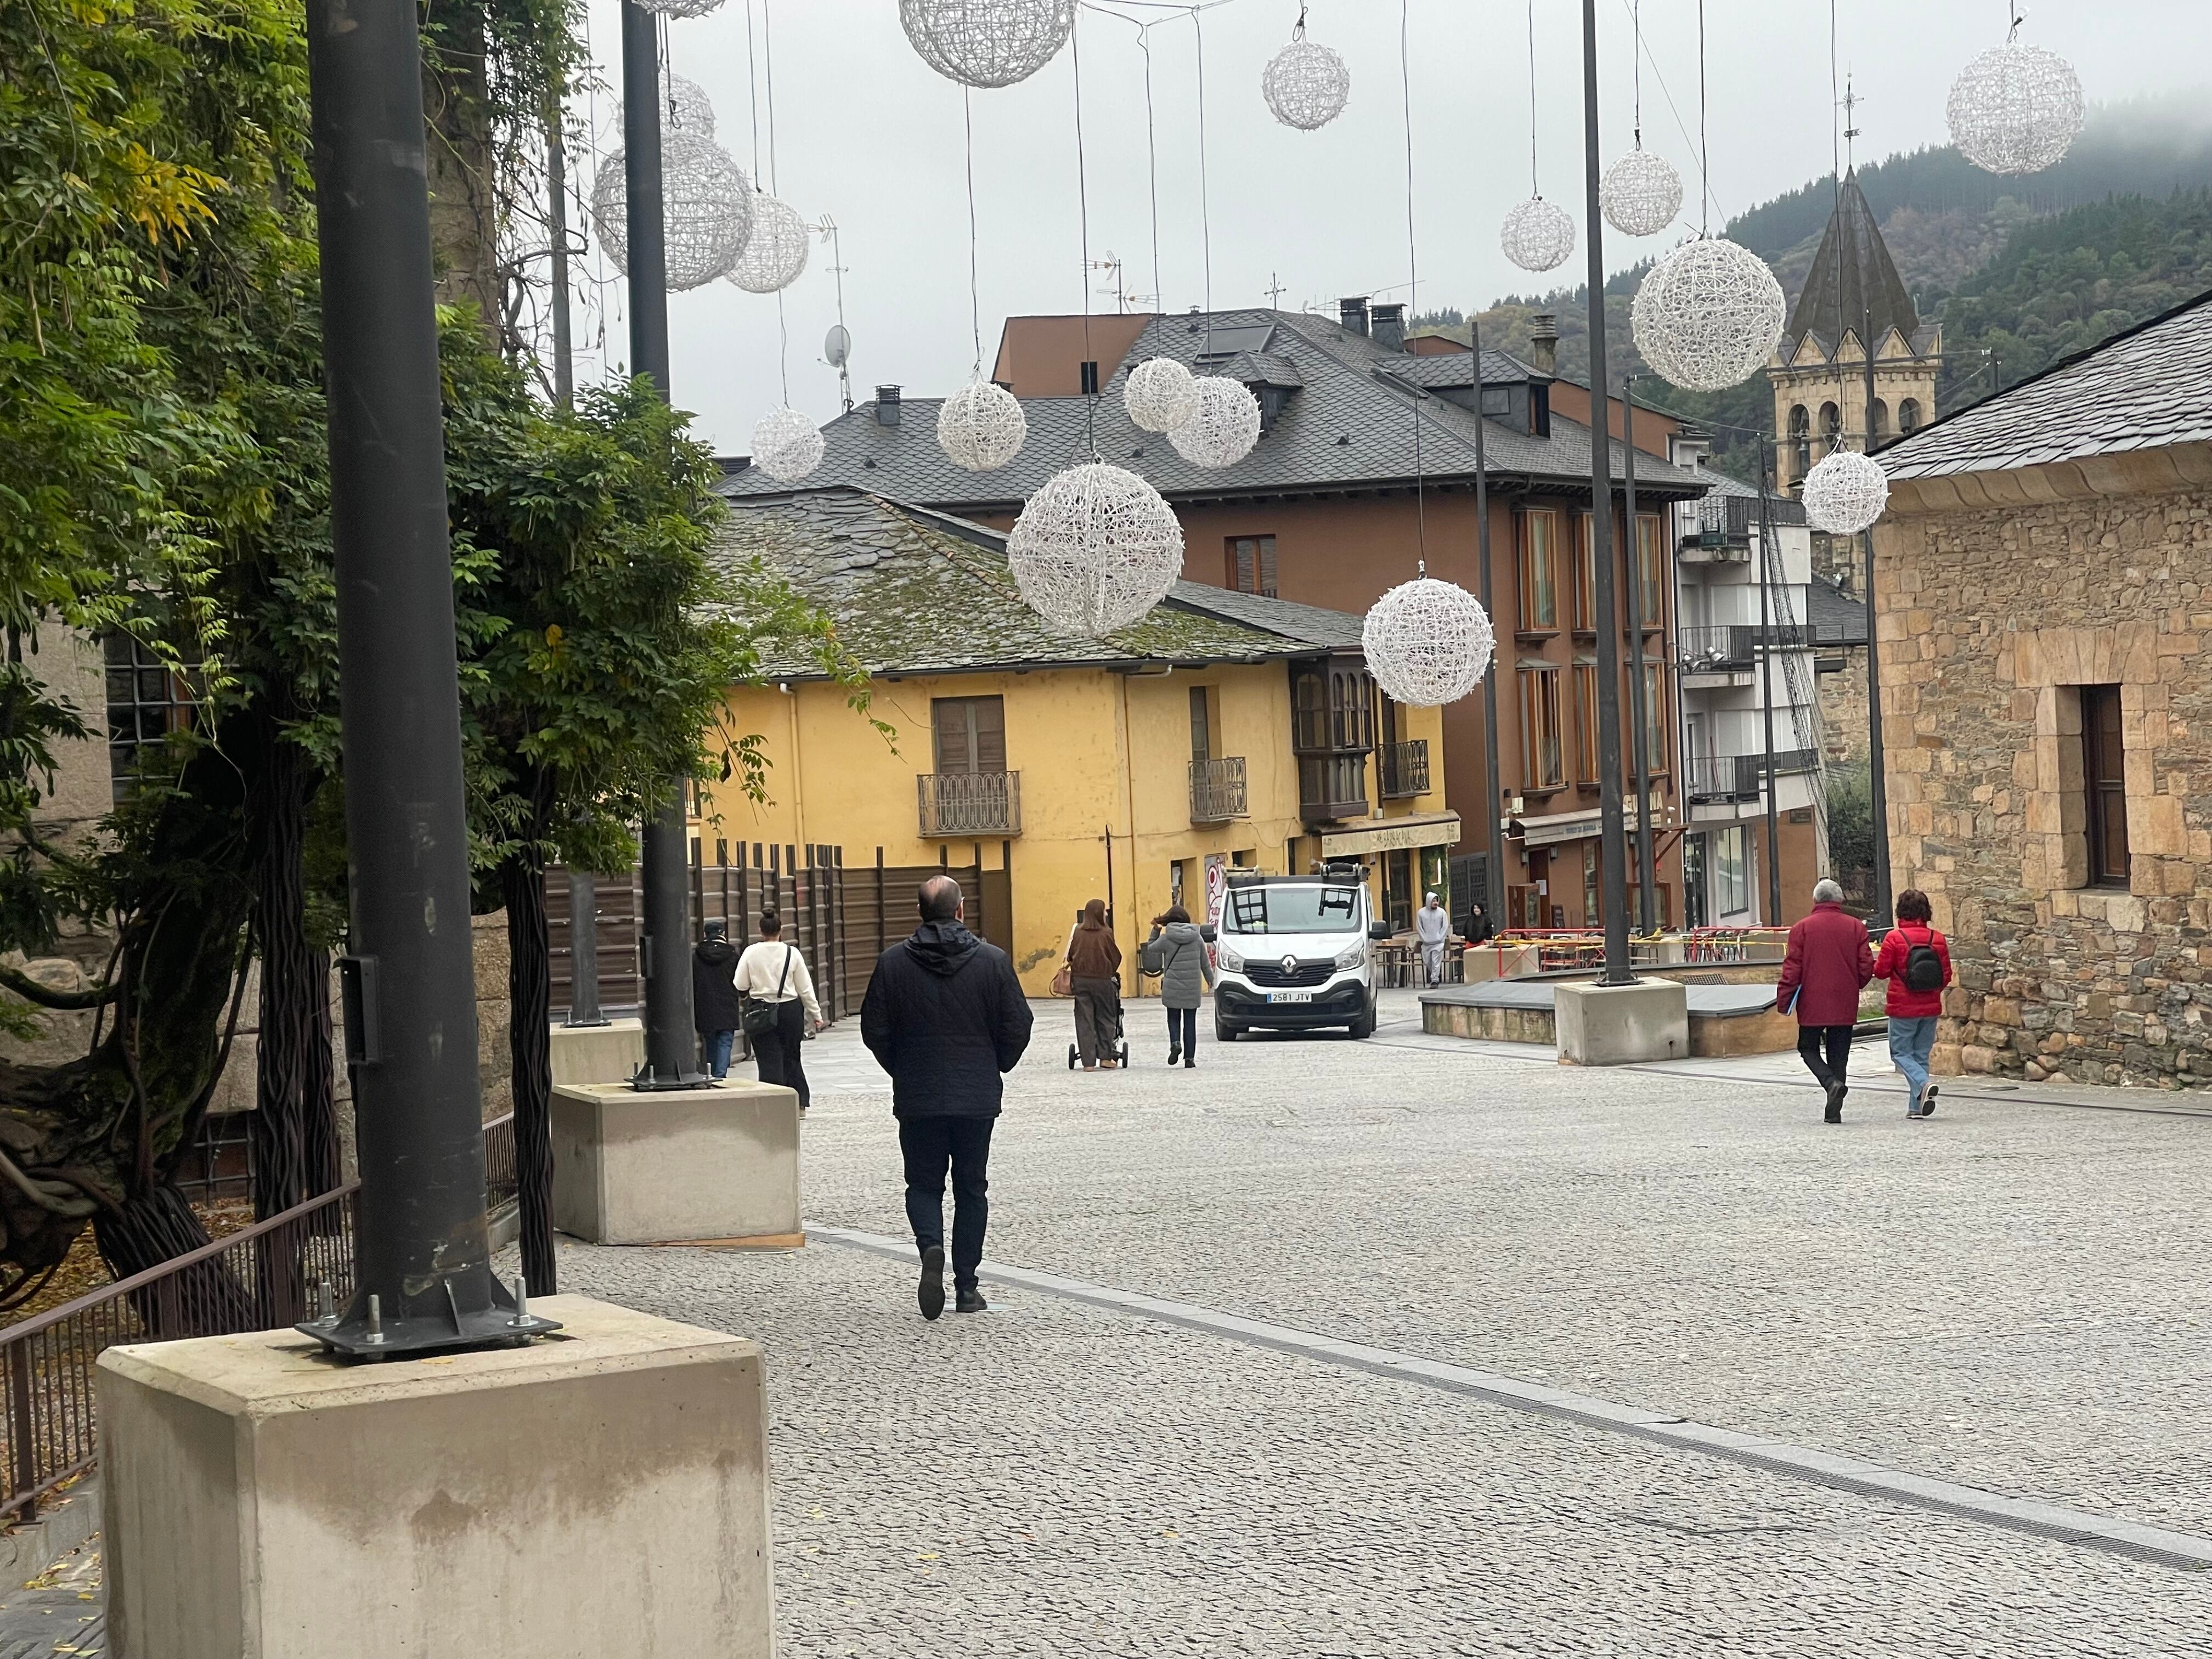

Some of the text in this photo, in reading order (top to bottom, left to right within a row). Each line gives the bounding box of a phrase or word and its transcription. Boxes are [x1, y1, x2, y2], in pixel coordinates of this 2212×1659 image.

[1623, 791, 1663, 813] GUNA
[1273, 993, 1310, 1001] 2581 JTV
